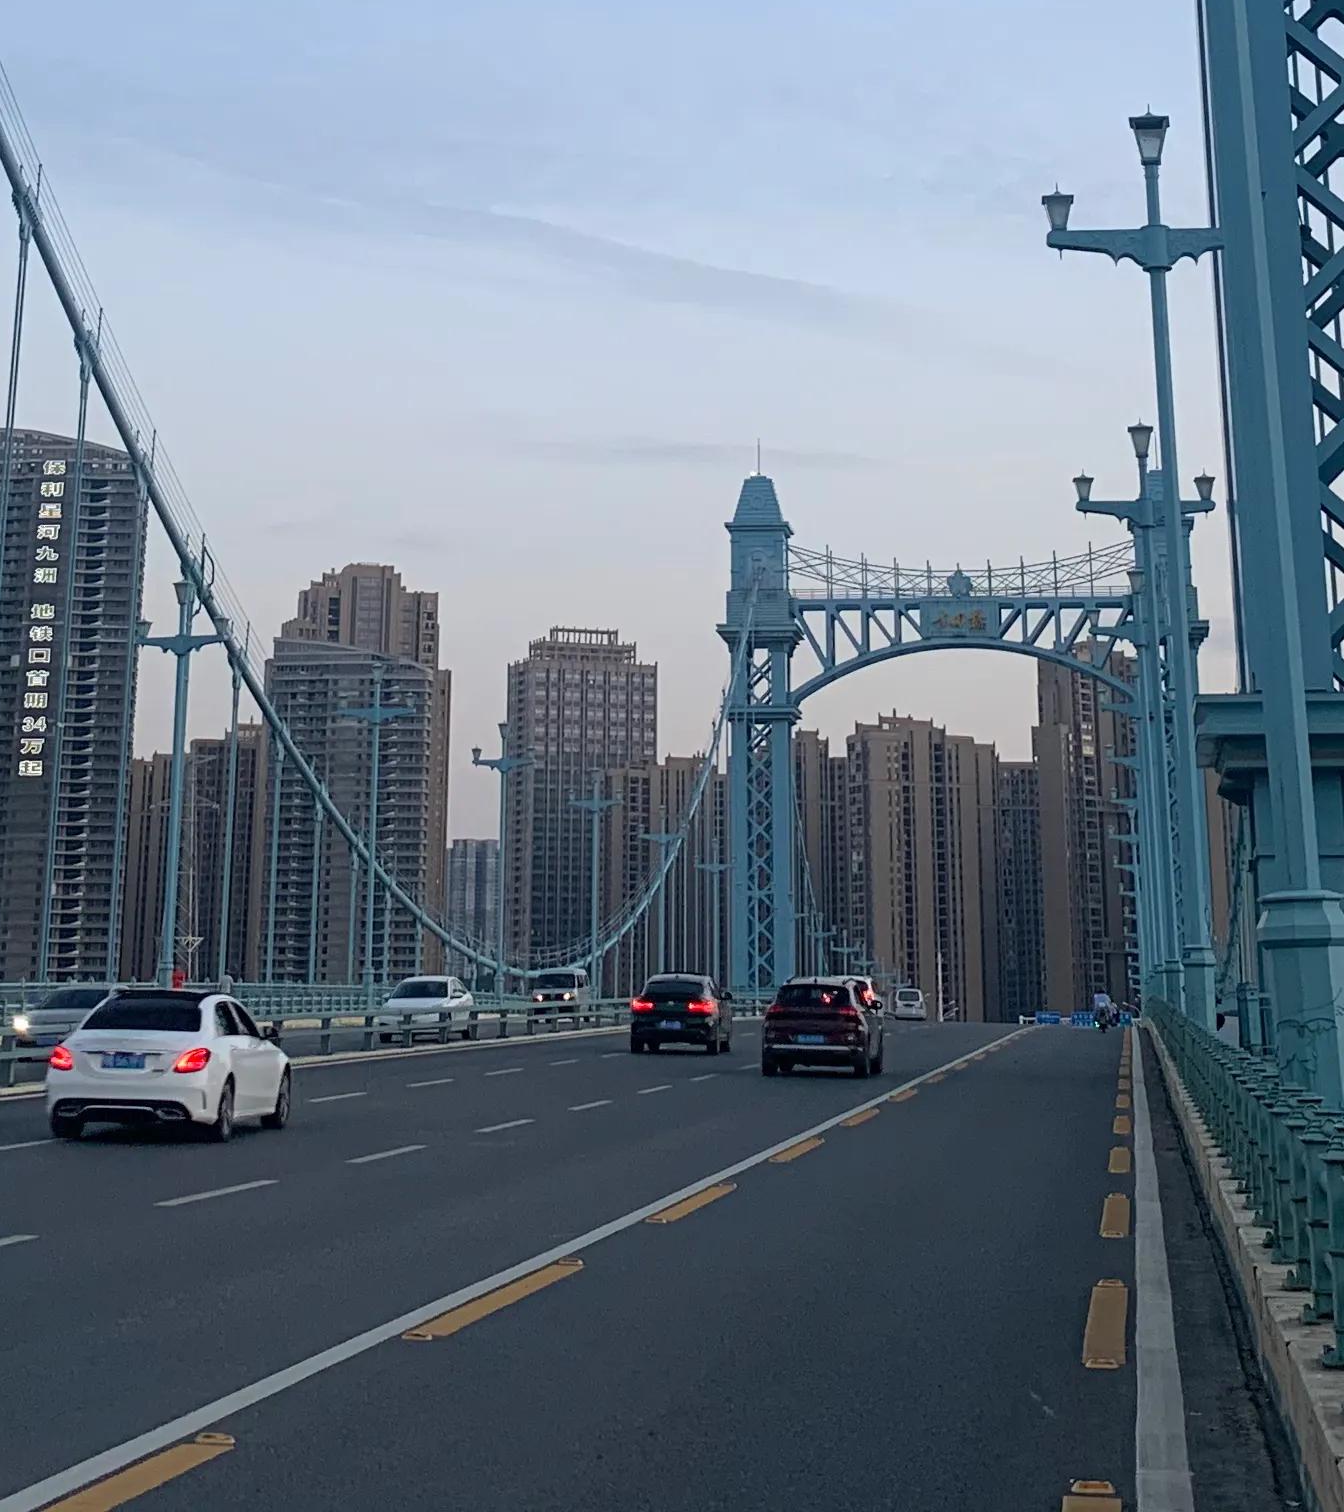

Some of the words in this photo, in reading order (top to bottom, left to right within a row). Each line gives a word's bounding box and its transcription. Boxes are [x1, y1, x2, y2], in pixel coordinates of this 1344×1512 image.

[33, 459, 67, 584] 保利星河九洲
[18, 603, 55, 777] 地铁口首期34万起
